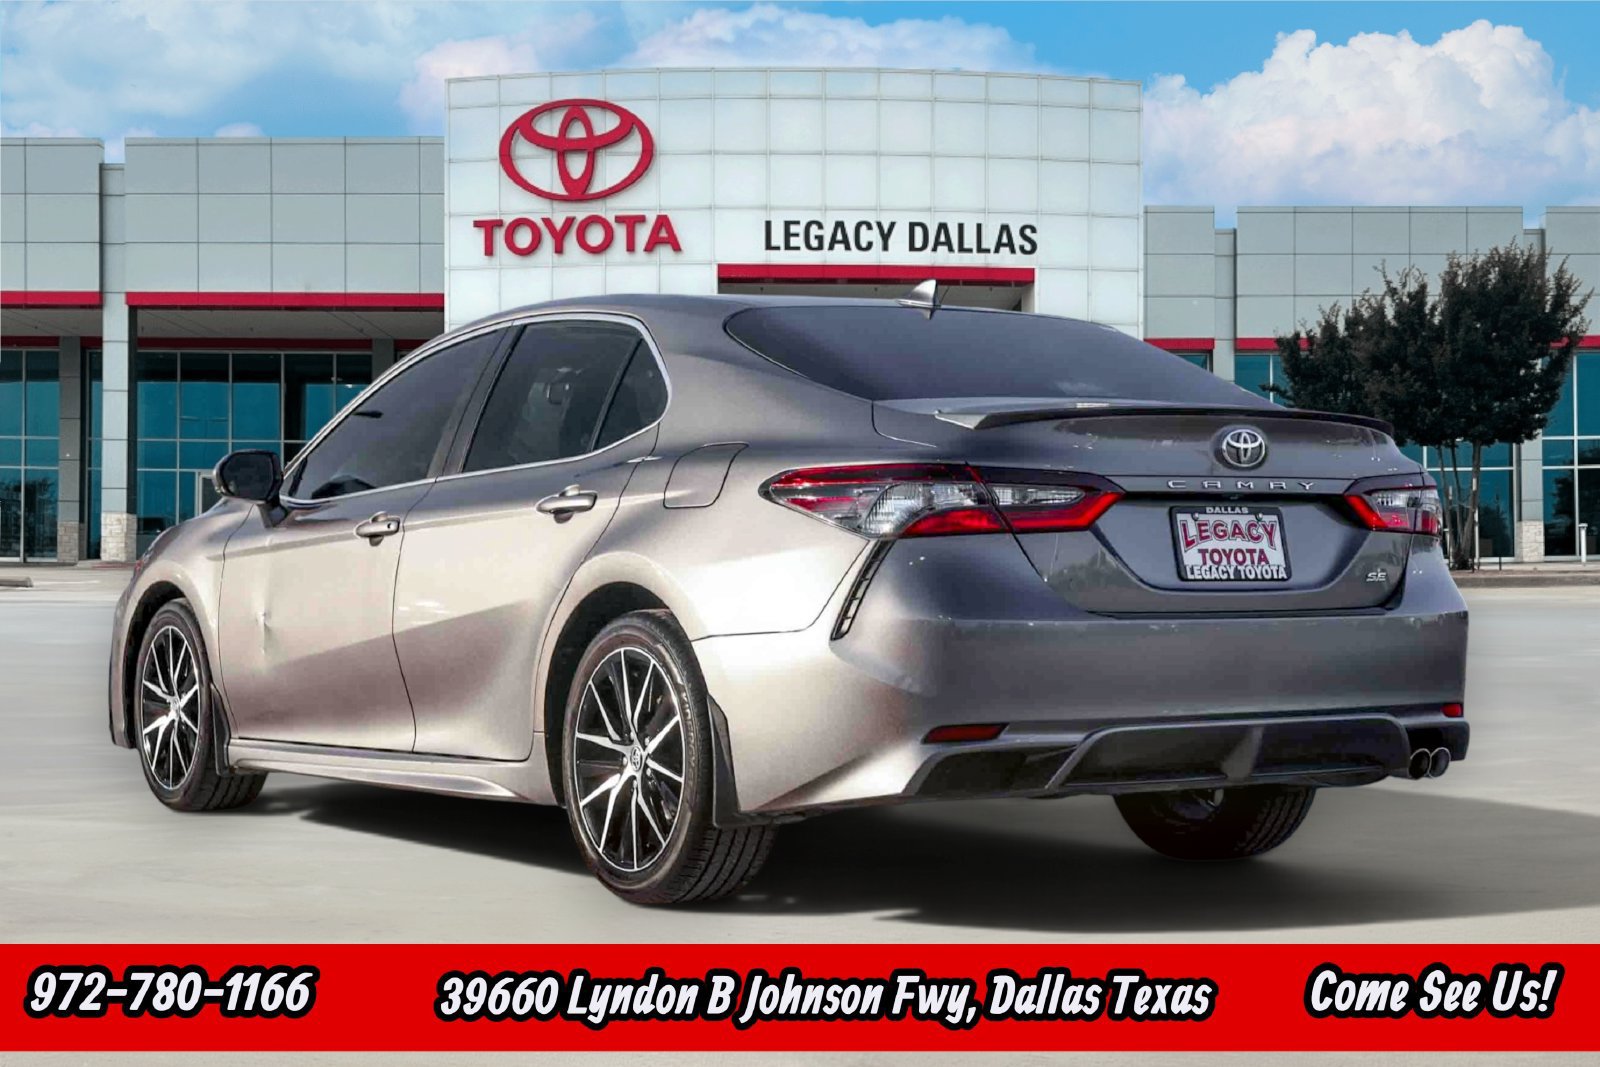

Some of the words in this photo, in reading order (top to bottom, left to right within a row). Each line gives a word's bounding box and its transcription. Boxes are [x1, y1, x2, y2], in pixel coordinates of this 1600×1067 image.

[474, 214, 681, 256] TOYOTA
[765, 220, 896, 252] LEGACY
[908, 222, 1038, 255] DALLAS
[1167, 479, 1315, 491] CAMRY
[1205, 506, 1249, 514] DALLAS
[1180, 520, 1277, 552] LEGACY
[1198, 548, 1270, 566] TOYOTA
[1186, 565, 1235, 579] LEGACY
[1238, 565, 1287, 579] TOYOTA
[1366, 571, 1387, 582] SE
